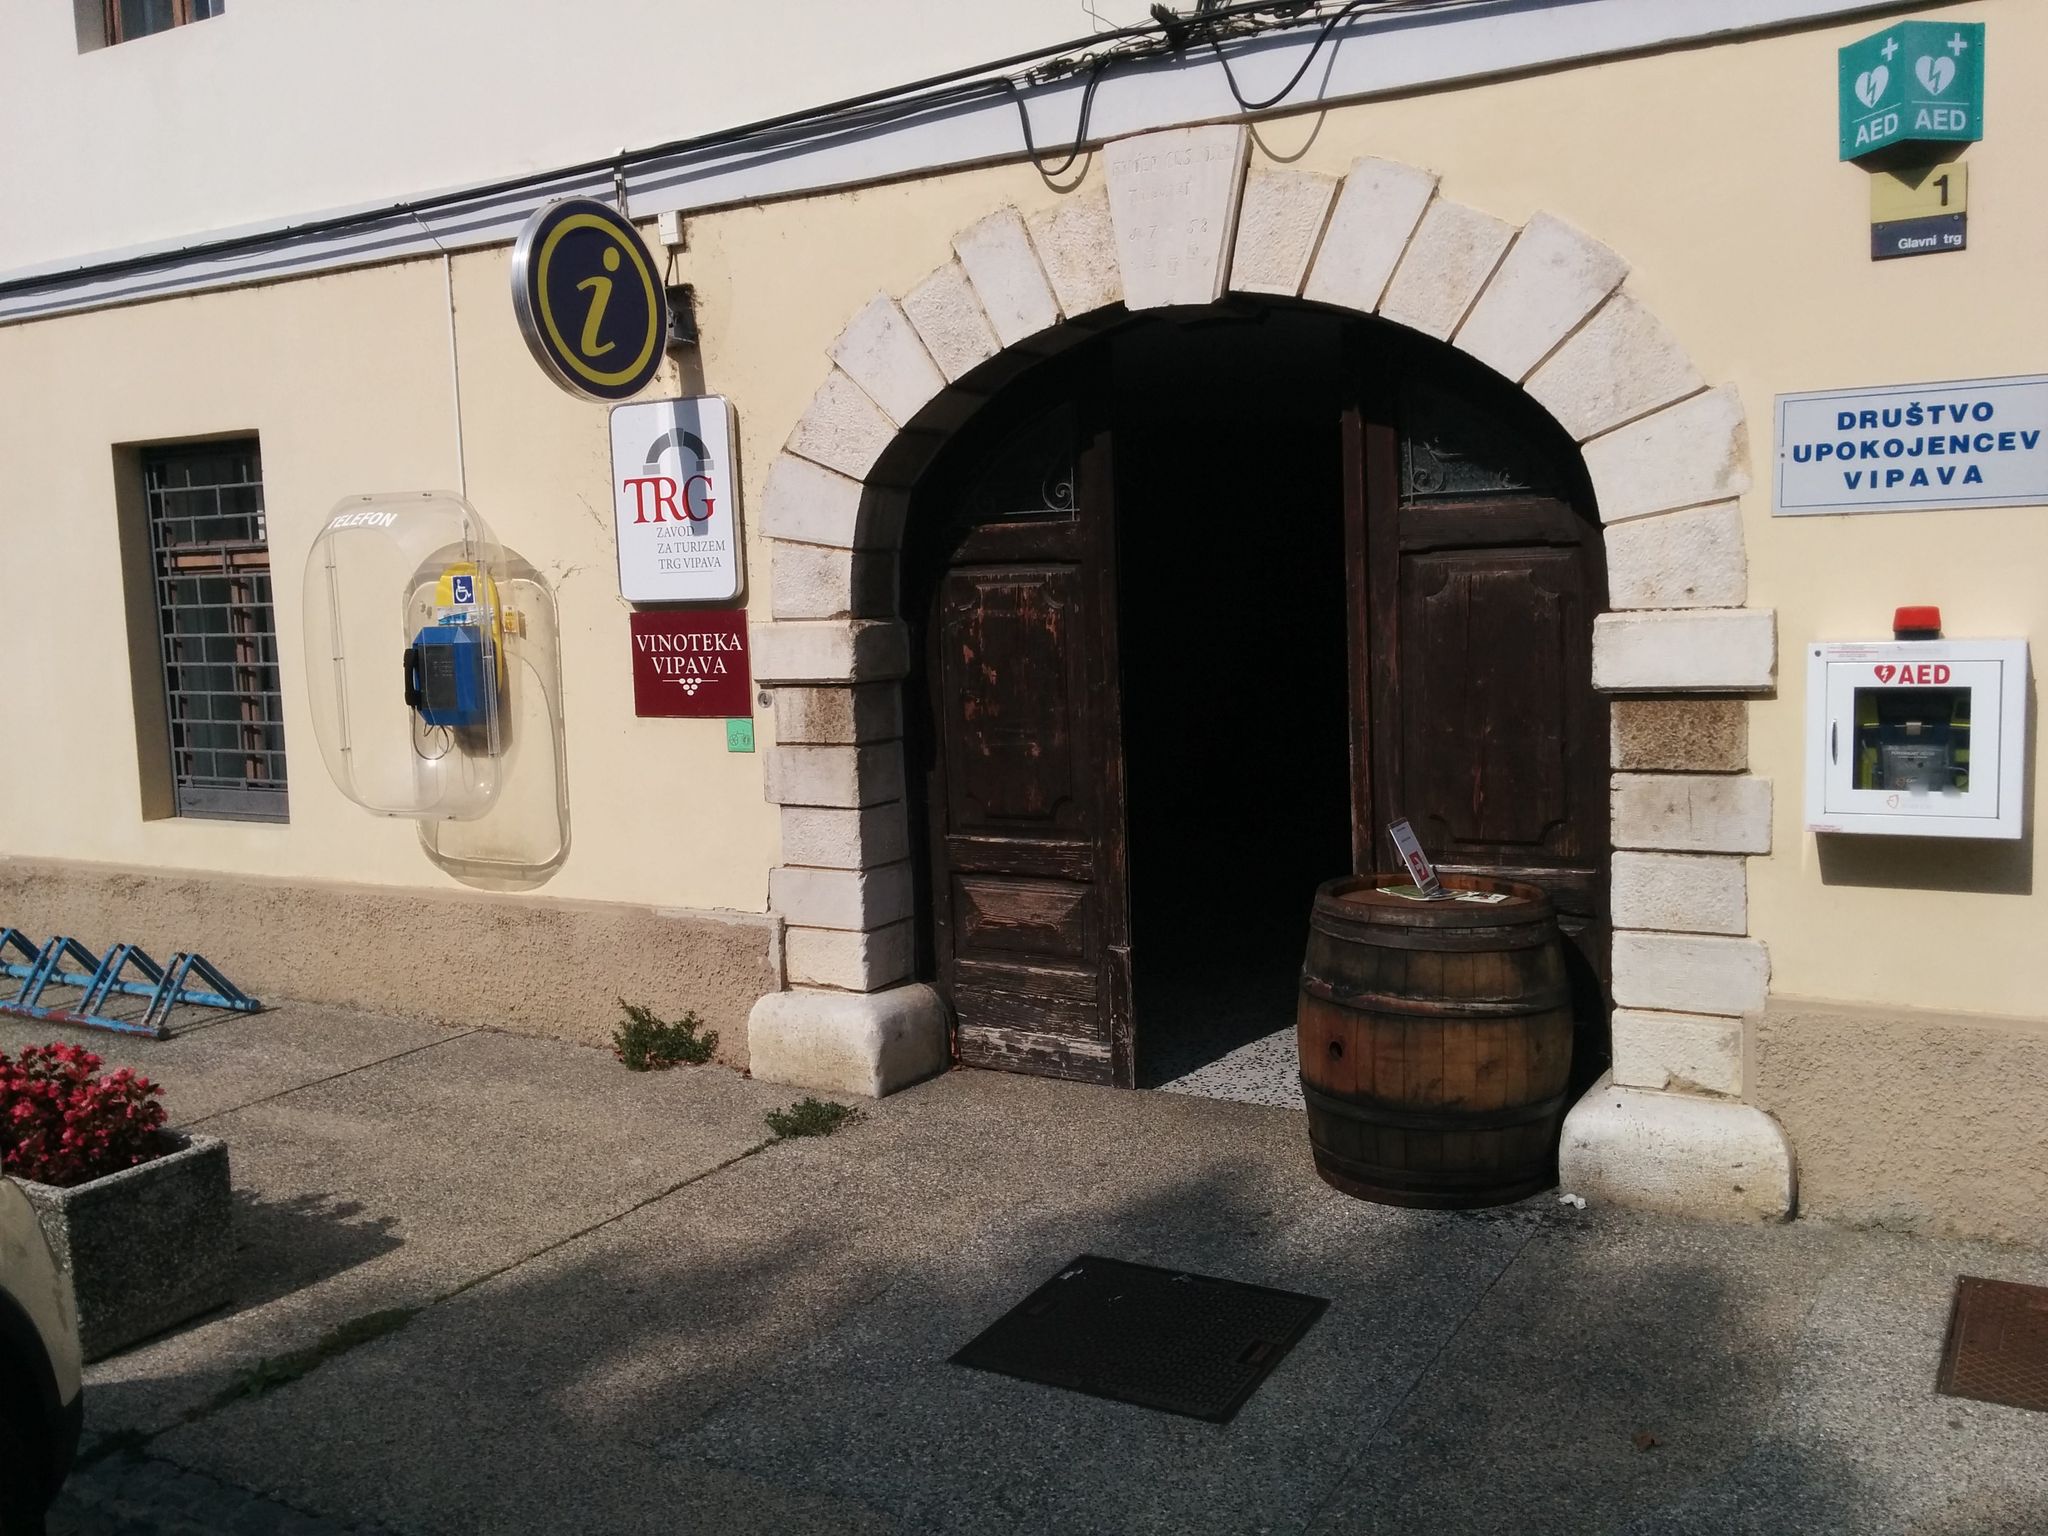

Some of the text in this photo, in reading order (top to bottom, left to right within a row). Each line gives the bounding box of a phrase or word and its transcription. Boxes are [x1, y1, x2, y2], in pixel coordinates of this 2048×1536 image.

[1855, 113, 1899, 147] AED
[1915, 109, 1967, 131] AED
[1932, 174, 1949, 207] 1
[1898, 233, 1962, 250] Glavni trg
[1837, 402, 1994, 431] DRUŠTVO
[1793, 430, 2041, 463] UPOKOJENCEV
[1844, 465, 1984, 490] VIPAVA
[623, 475, 716, 524] TRG
[327, 512, 398, 530] TELEFON
[656, 526, 695, 538] ZAVOD
[657, 540, 725, 554] ZA TURIZEM
[658, 556, 722, 570] TRG VIPAVA
[636, 633, 743, 652] VINOTEKA
[651, 656, 728, 675] VIPAVA
[1898, 664, 1950, 685] AED
